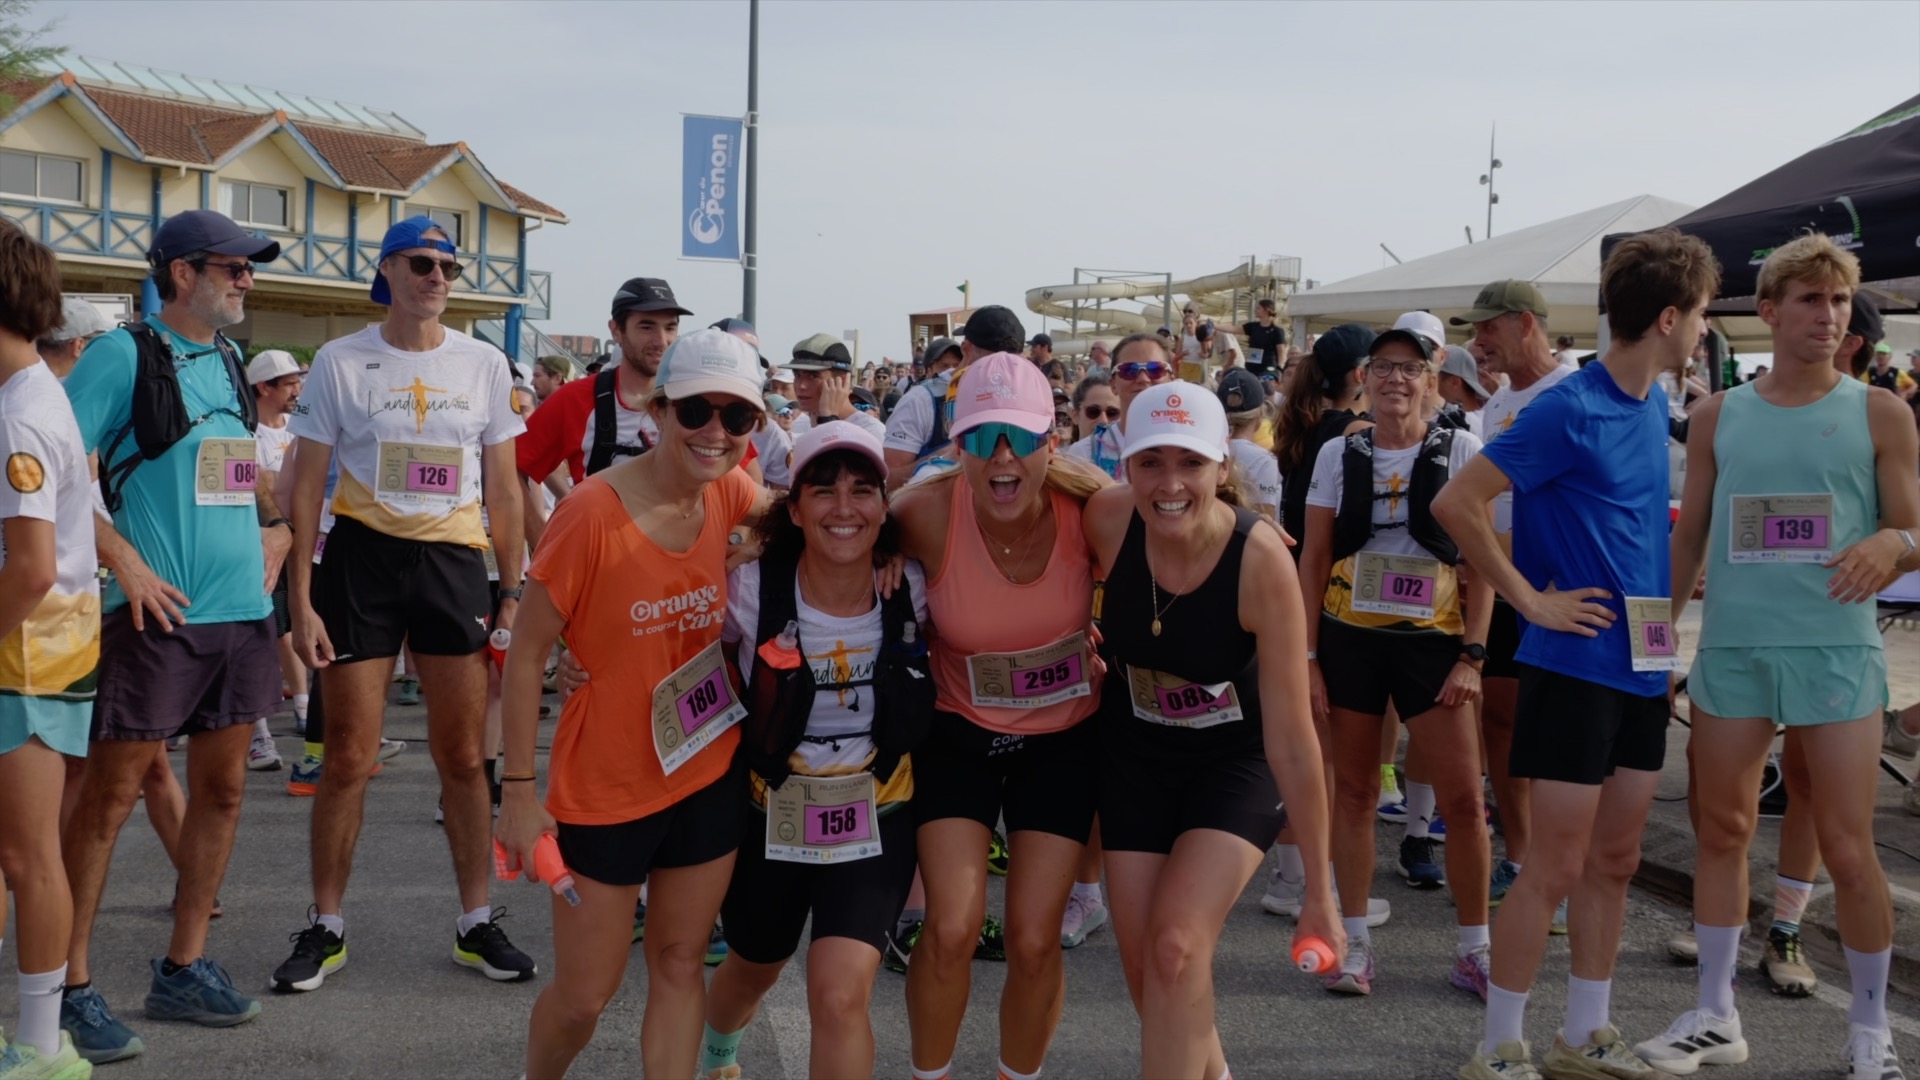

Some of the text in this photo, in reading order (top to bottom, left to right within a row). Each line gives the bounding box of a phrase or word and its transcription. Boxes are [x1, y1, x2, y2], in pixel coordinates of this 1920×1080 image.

[706, 133, 728, 215] Penon
[418, 466, 448, 486] 126
[1776, 519, 1814, 540] 139
[1393, 577, 1423, 597] 072
[630, 584, 720, 622] Orange
[632, 620, 677, 636] la course
[678, 607, 725, 633] Care
[1647, 626, 1666, 647] 046
[1024, 661, 1070, 690] 295
[686, 680, 718, 718] 180
[992, 735, 1024, 747] COM
[817, 807, 856, 836] 158
